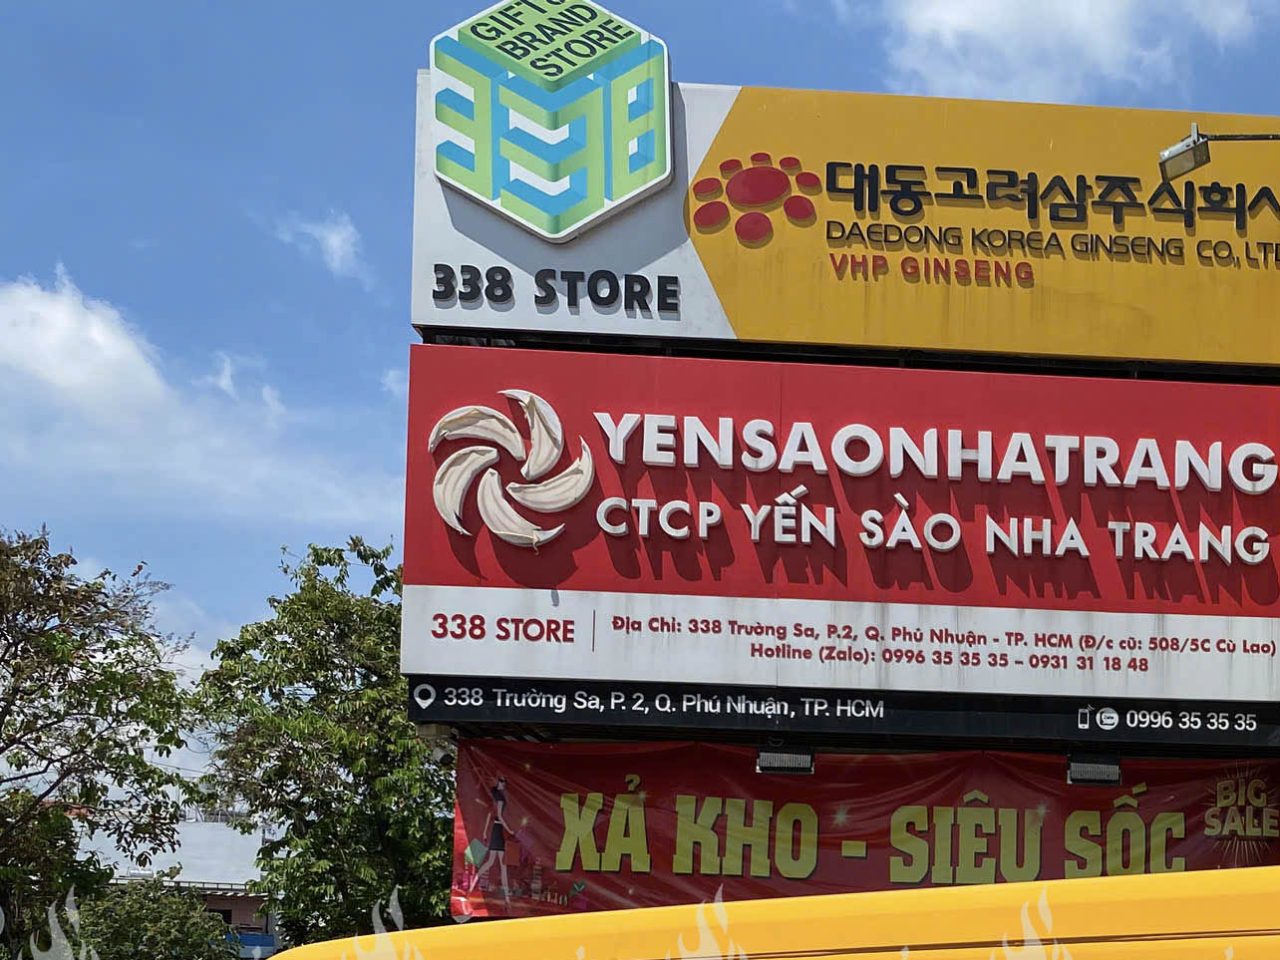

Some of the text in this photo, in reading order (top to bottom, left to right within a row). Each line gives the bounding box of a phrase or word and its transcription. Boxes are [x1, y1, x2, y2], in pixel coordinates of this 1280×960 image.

[495, 4, 598, 60] BRAND
[530, 19, 634, 77] STORE
[826, 220, 962, 248] DAEDONG
[971, 226, 1063, 255] KOREA
[1071, 231, 1184, 261] GINSENG
[829, 252, 1034, 284] VHP GINSENG
[432, 263, 680, 317] 338 STORE
[594, 411, 1279, 496] YENSAONHATRANG
[596, 485, 1271, 566] CTCP YẾN SÀO NHA TRANG
[431, 613, 575, 643] 338 STORE
[611, 616, 642, 635] Địa
[688, 619, 722, 634] 338
[793, 623, 820, 640] Sa,
[827, 624, 858, 642] P.2,
[865, 625, 885, 642] Q.
[930, 627, 987, 648] Nhuận
[1005, 631, 1028, 647] TP.
[1034, 632, 1073, 649] HCM
[1148, 636, 1211, 653] 508/5C
[1243, 639, 1277, 657] Lao)
[751, 643, 813, 660] Hotline
[881, 648, 926, 665] 0996
[932, 650, 954, 667] 35
[960, 651, 982, 667] 35
[988, 652, 1009, 668] 35
[1029, 654, 1068, 670] 0931
[1076, 655, 1095, 671] 31
[1103, 656, 1122, 672] 18
[1127, 657, 1149, 672] 48
[443, 686, 484, 707] 338
[492, 686, 567, 713] Trường
[573, 690, 605, 712] Sa,
[610, 692, 627, 710] P.
[631, 692, 650, 714] 2,
[655, 693, 677, 713] Q.
[682, 693, 720, 715] Phú
[800, 697, 830, 717] TP.
[836, 698, 884, 718] HCM
[1126, 709, 1258, 732] 0996 35 35 35
[1216, 778, 1268, 808] BIG
[554, 774, 651, 872] XẢ
[671, 794, 819, 880] KHO
[887, 788, 1045, 885] SIÊU
[1061, 782, 1186, 880] SỐC
[1203, 805, 1280, 838] SALE
